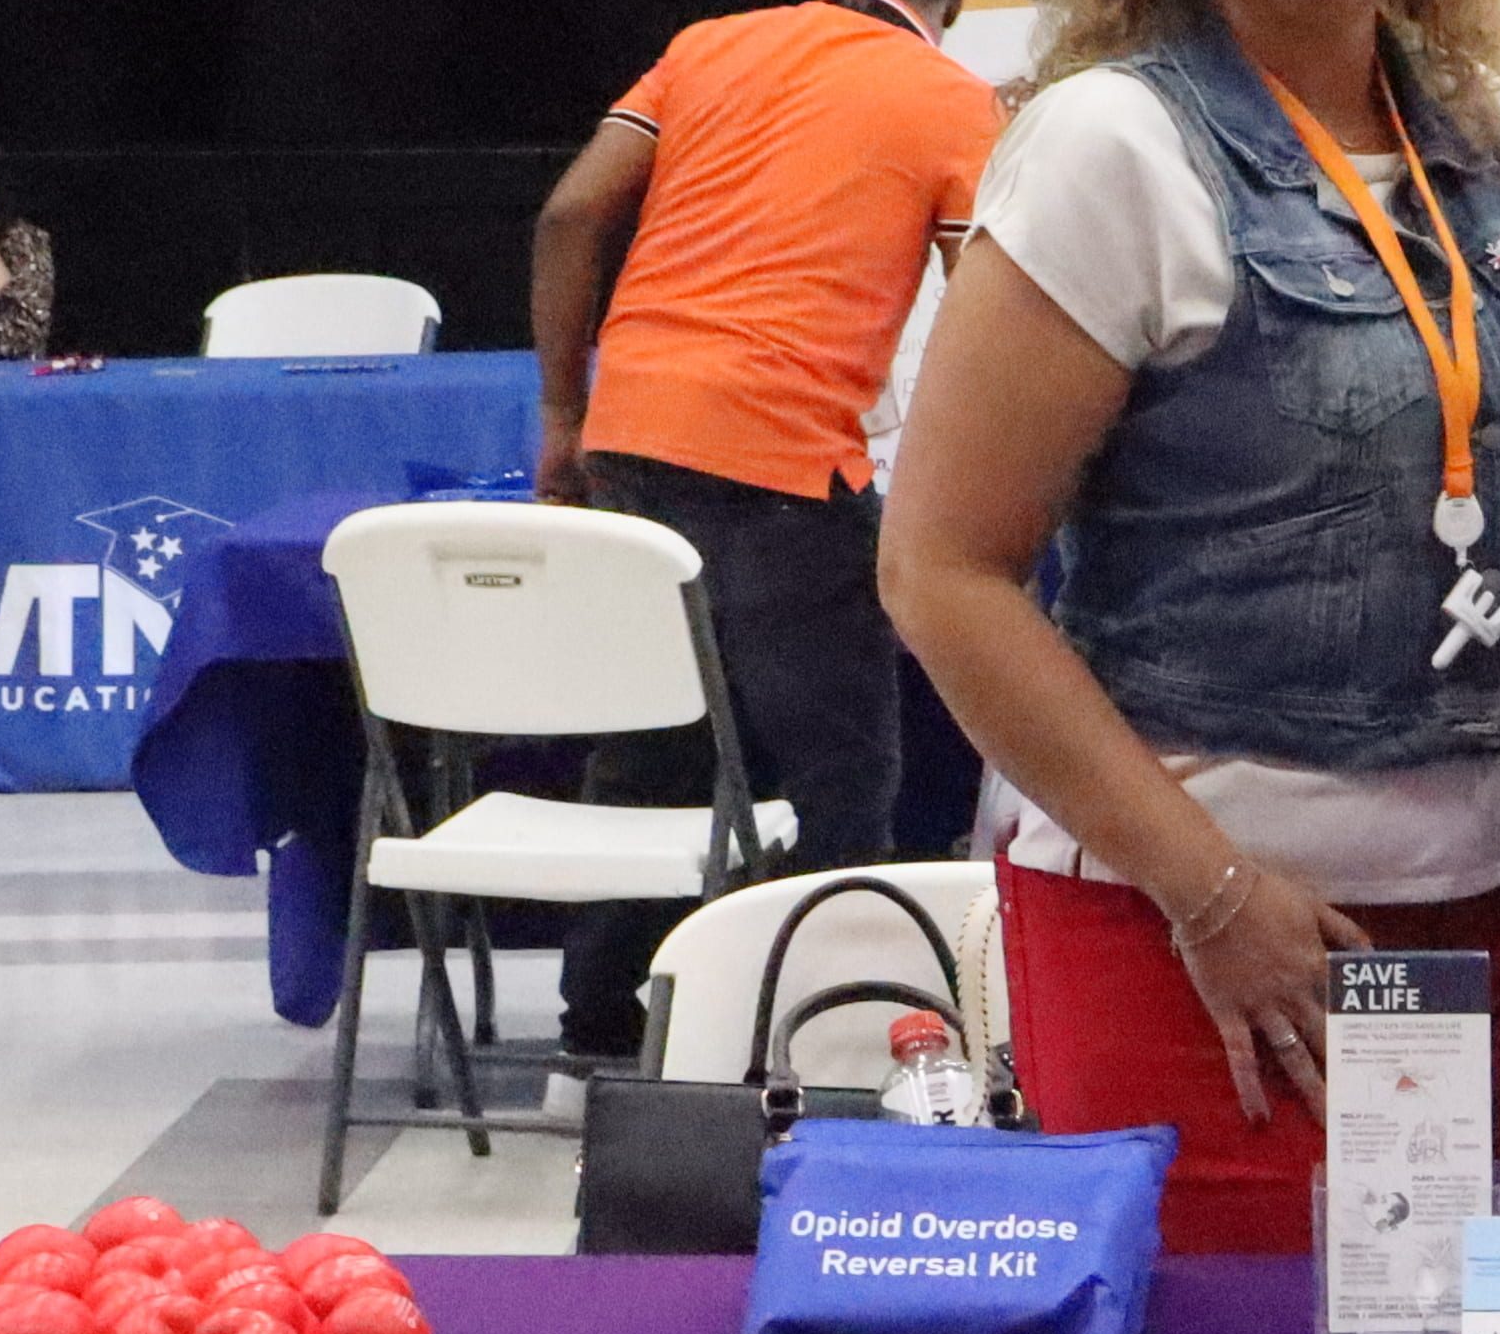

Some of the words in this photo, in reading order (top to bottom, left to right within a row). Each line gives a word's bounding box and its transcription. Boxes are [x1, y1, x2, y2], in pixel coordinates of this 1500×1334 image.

[1341, 962, 1408, 987] SAVE
[1341, 988, 1364, 1011] A
[1367, 987, 1421, 1011] LIFE
[789, 1210, 903, 1243] Opioid
[912, 1212, 1079, 1242] Overdose
[821, 1249, 978, 1278] Reversal
[988, 1251, 1038, 1278] Kit
